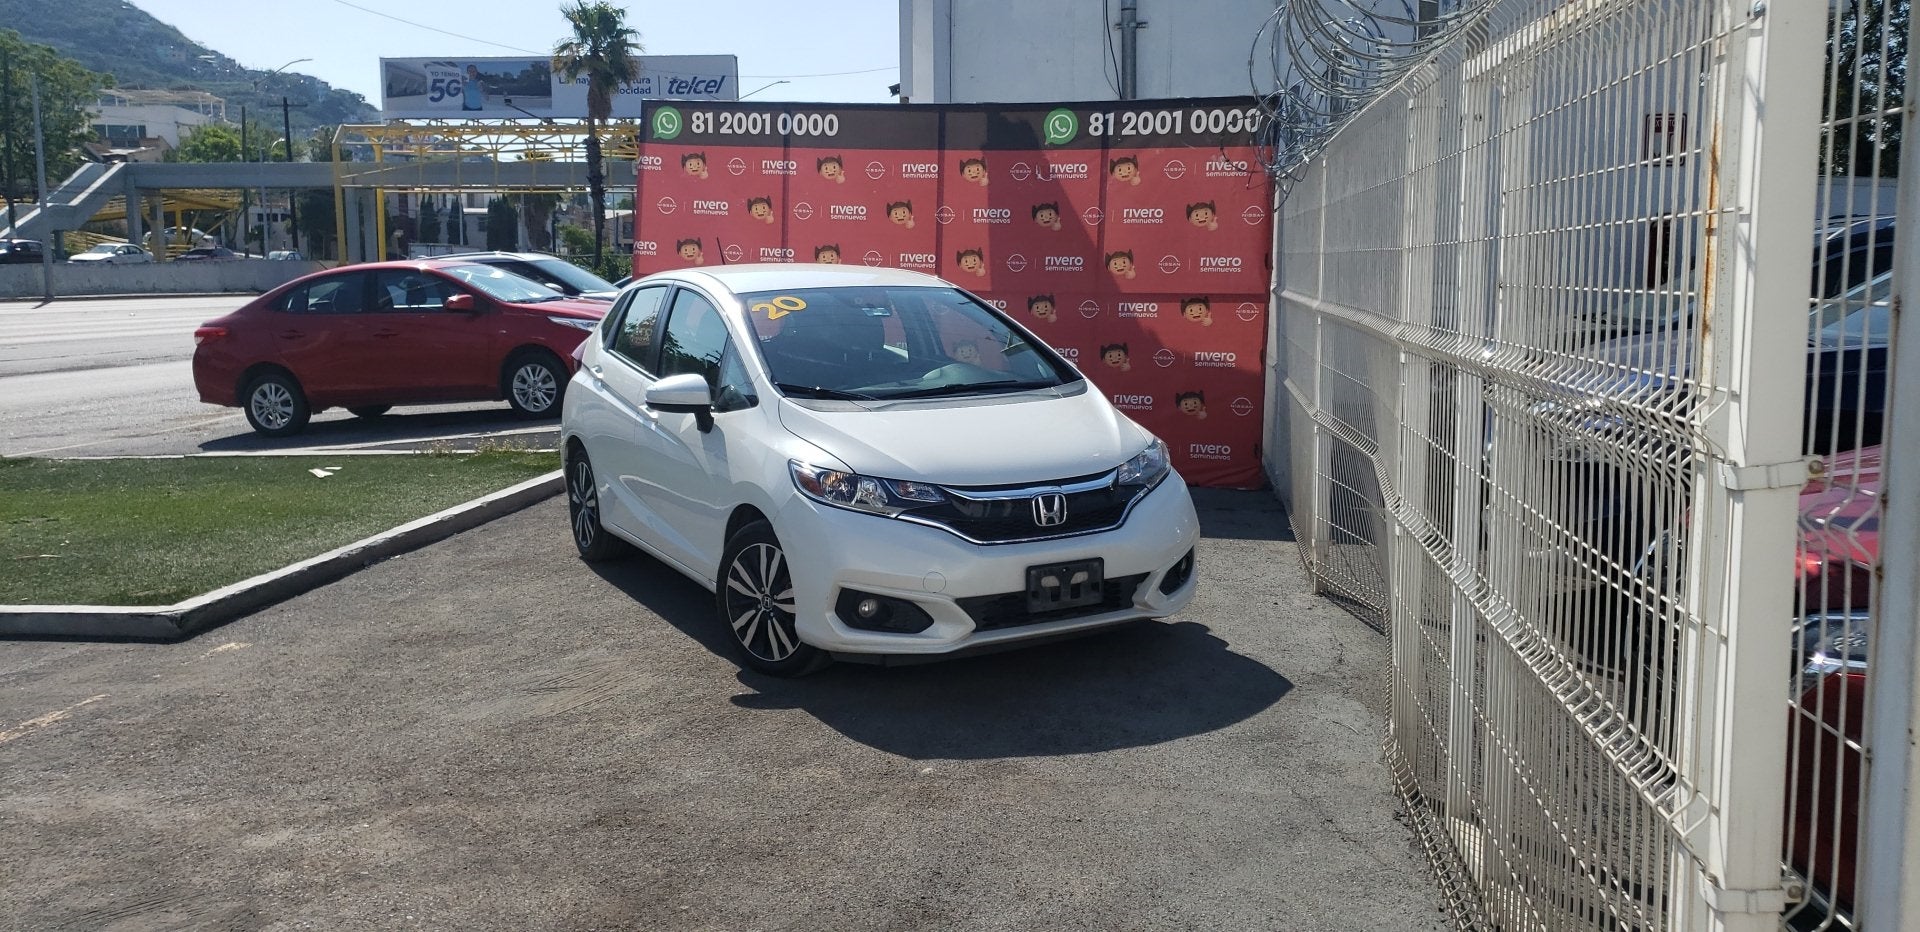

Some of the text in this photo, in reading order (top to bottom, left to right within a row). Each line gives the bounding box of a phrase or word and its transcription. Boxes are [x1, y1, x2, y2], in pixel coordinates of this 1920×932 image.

[667, 75, 726, 95] telcel
[429, 78, 462, 103] 5G
[691, 111, 839, 137] 81 2001 0000
[1088, 108, 1261, 137] 81 2001 0000
[762, 159, 797, 170] rivero
[902, 162, 939, 173] rivero
[1049, 163, 1088, 173] rivero
[1205, 160, 1248, 171] rivero
[693, 200, 729, 210] rivero
[830, 204, 867, 214] rivero
[973, 208, 1011, 218] rivero
[1123, 208, 1164, 218] rivero
[760, 247, 795, 257] rivero
[900, 253, 936, 263] rivero
[1045, 256, 1084, 266] rivero
[1200, 256, 1242, 267] rivero
[751, 296, 807, 320] 20
[1118, 302, 1158, 312] rivero
[1194, 351, 1236, 361] rivero
[1113, 394, 1153, 404] rivero
[1190, 443, 1231, 454] rivero
